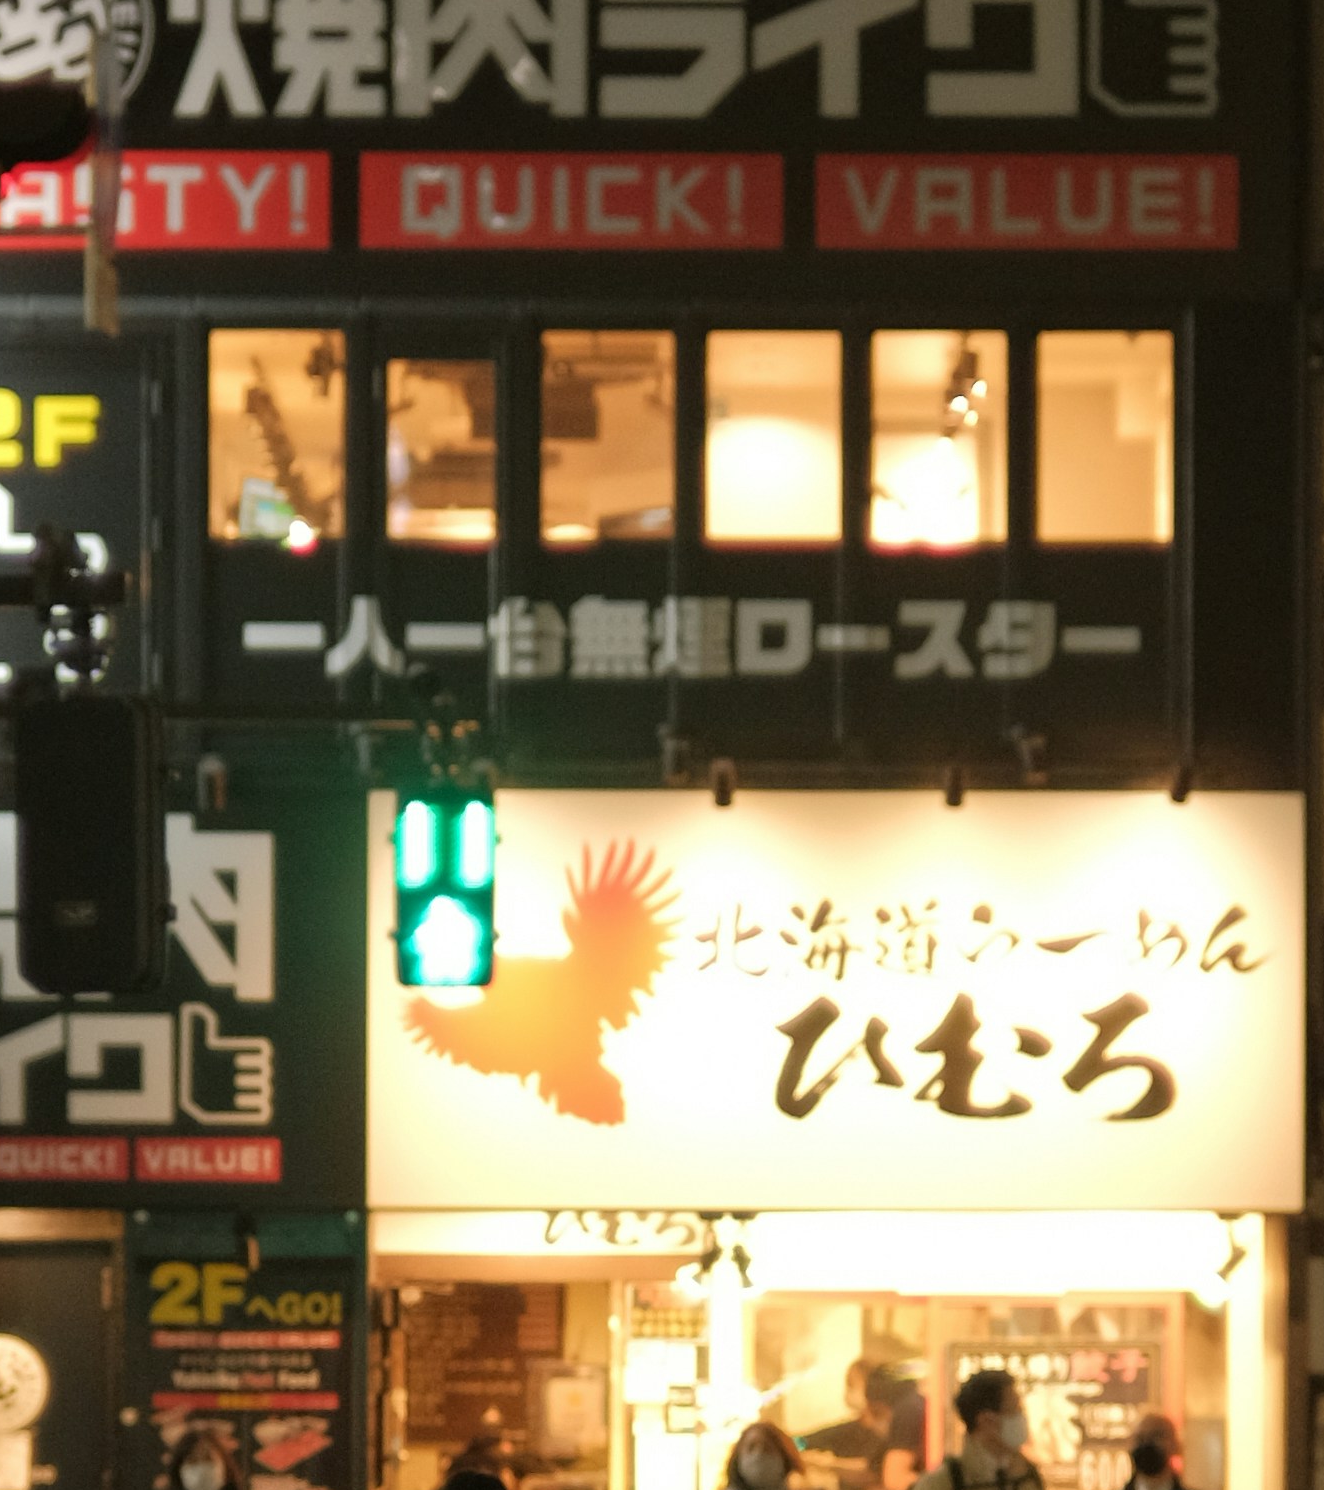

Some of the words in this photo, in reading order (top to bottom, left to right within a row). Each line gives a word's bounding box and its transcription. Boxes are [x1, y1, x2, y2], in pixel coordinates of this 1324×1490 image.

[398, 166, 747, 242] QUICK!
[847, 167, 1220, 236] VALUE!
[242, 594, 1142, 681] 一人一台無煙ロースター
[695, 898, 1275, 982] 北海道らーめん
[774, 993, 1176, 1122] ひむろ
[141, 1145, 272, 1174] VALUE!
